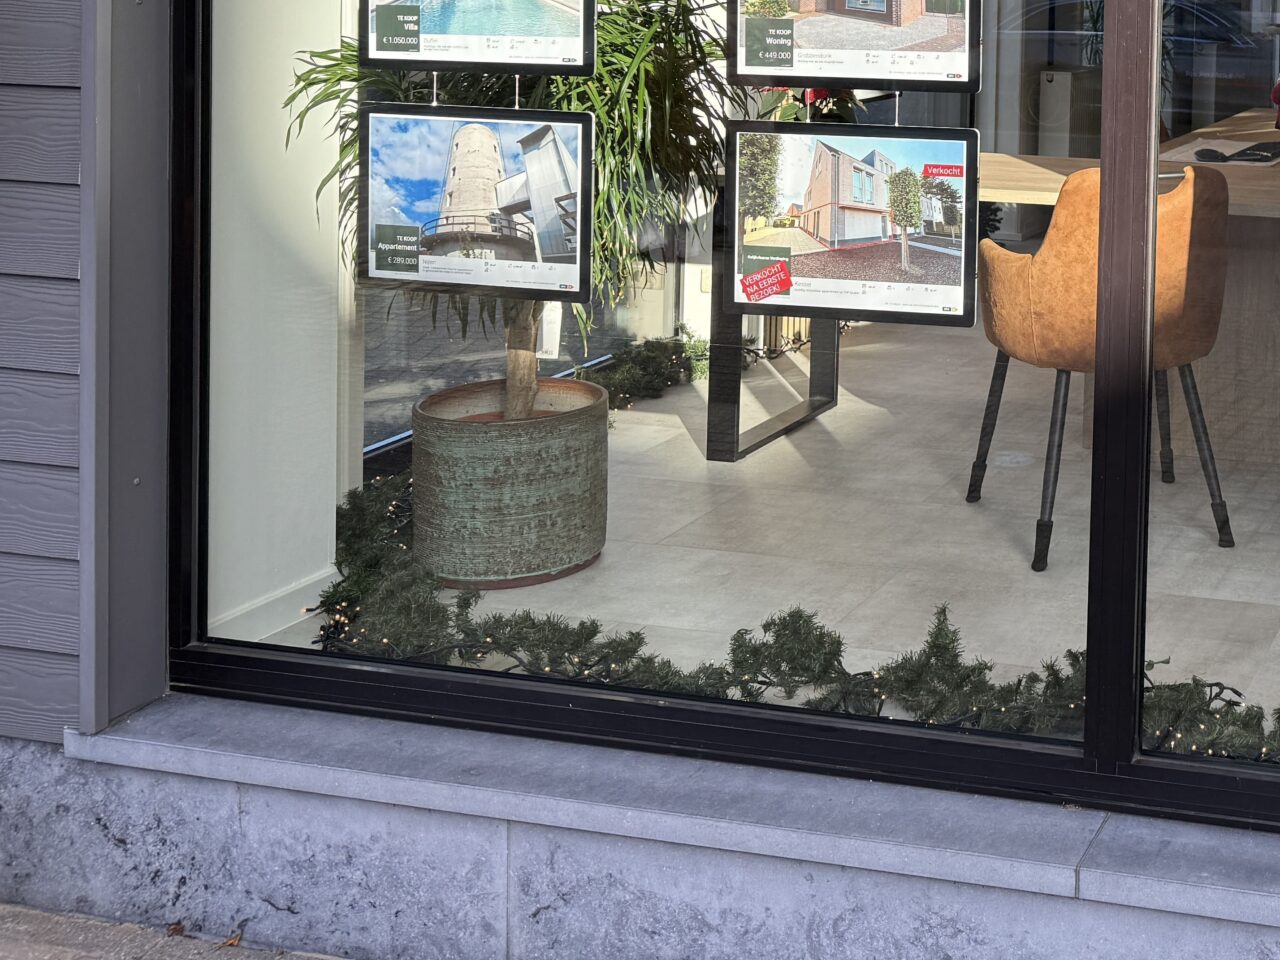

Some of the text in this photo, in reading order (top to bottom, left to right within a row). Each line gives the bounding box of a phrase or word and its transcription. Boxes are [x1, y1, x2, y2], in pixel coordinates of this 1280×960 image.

[388, 36, 418, 44] 1.050.000
[765, 37, 792, 46] Woning
[764, 51, 791, 59] 449.000
[927, 166, 961, 175] Verkocht
[378, 242, 417, 251] Appartement
[743, 263, 783, 286] VERKOCHT
[747, 272, 787, 294] NA EERSTE
[750, 285, 780, 302] BEZOEK!
